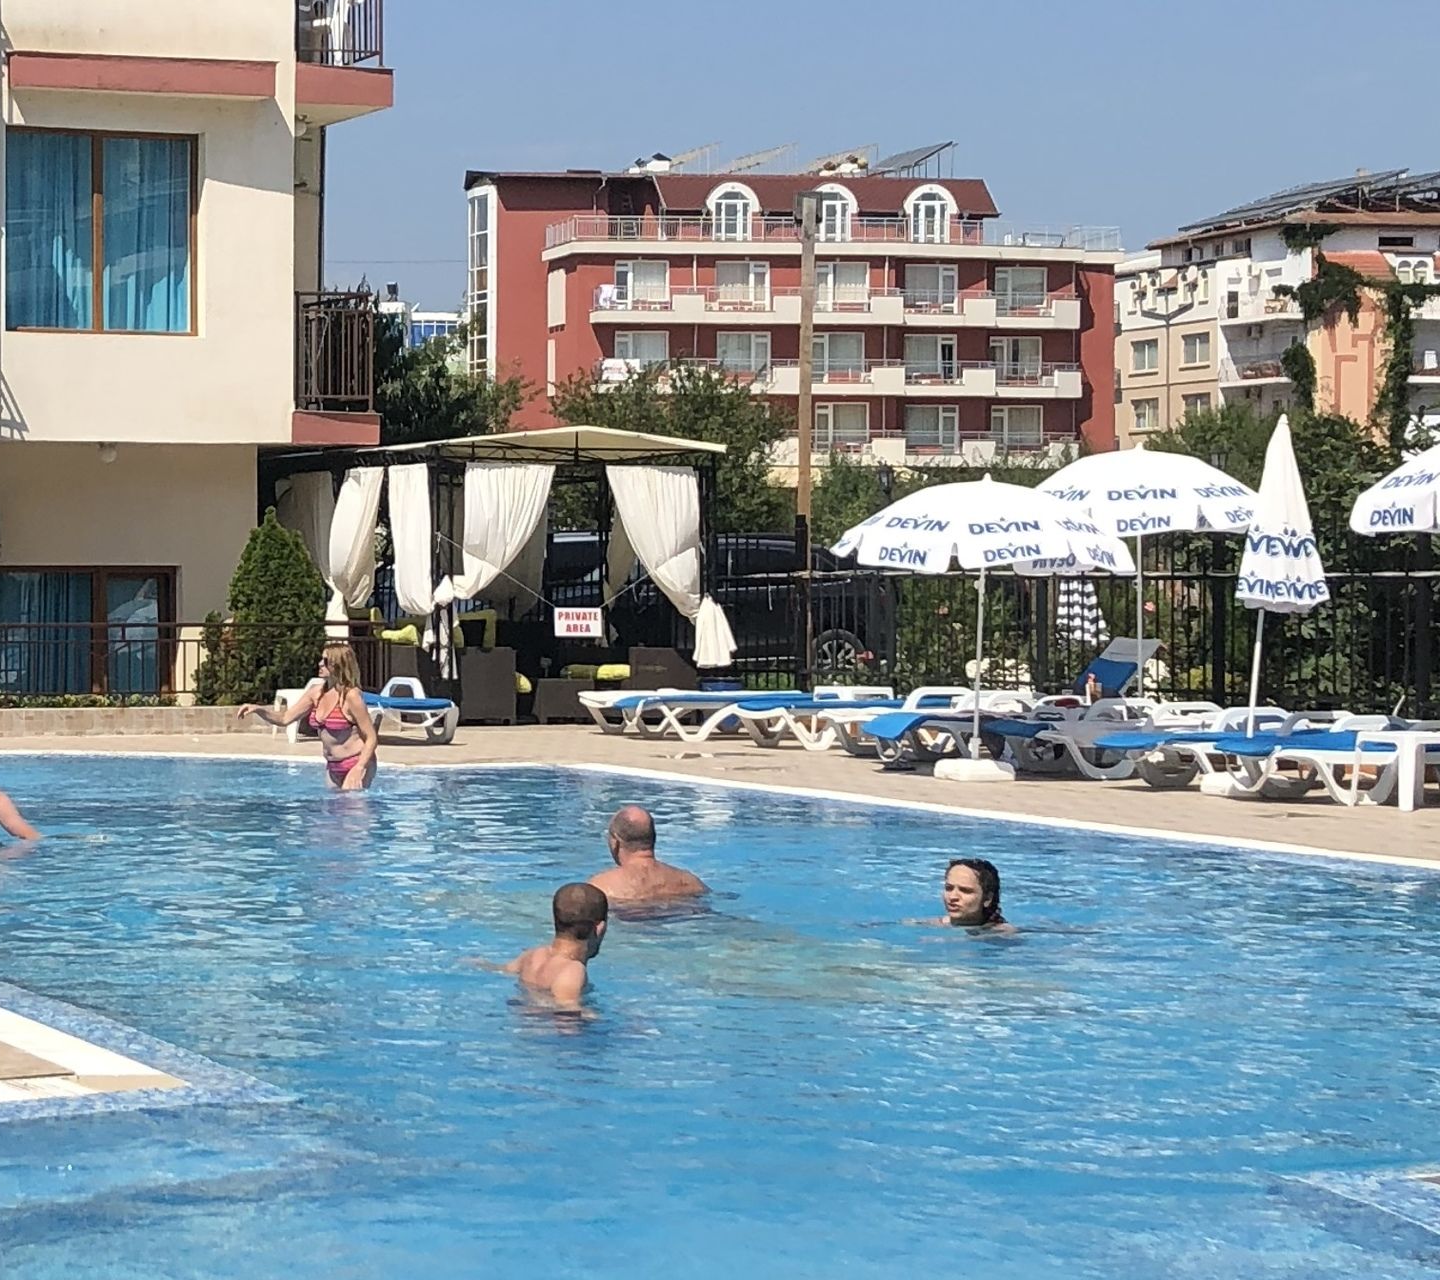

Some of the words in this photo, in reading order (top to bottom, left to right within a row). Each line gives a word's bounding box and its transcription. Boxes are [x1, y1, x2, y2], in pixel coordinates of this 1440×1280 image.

[1107, 489, 1176, 501] DEVIN
[1194, 486, 1249, 499] DEVIN
[886, 516, 950, 532] DEVIN
[1117, 516, 1170, 533] DEVIN
[1370, 507, 1414, 527] DEVIN
[968, 520, 1041, 535] DEVIN
[879, 546, 927, 566] DEVIN
[983, 544, 1041, 562] DEVIN
[558, 611, 599, 621] PRIVATE
[566, 623, 591, 633] AREA
